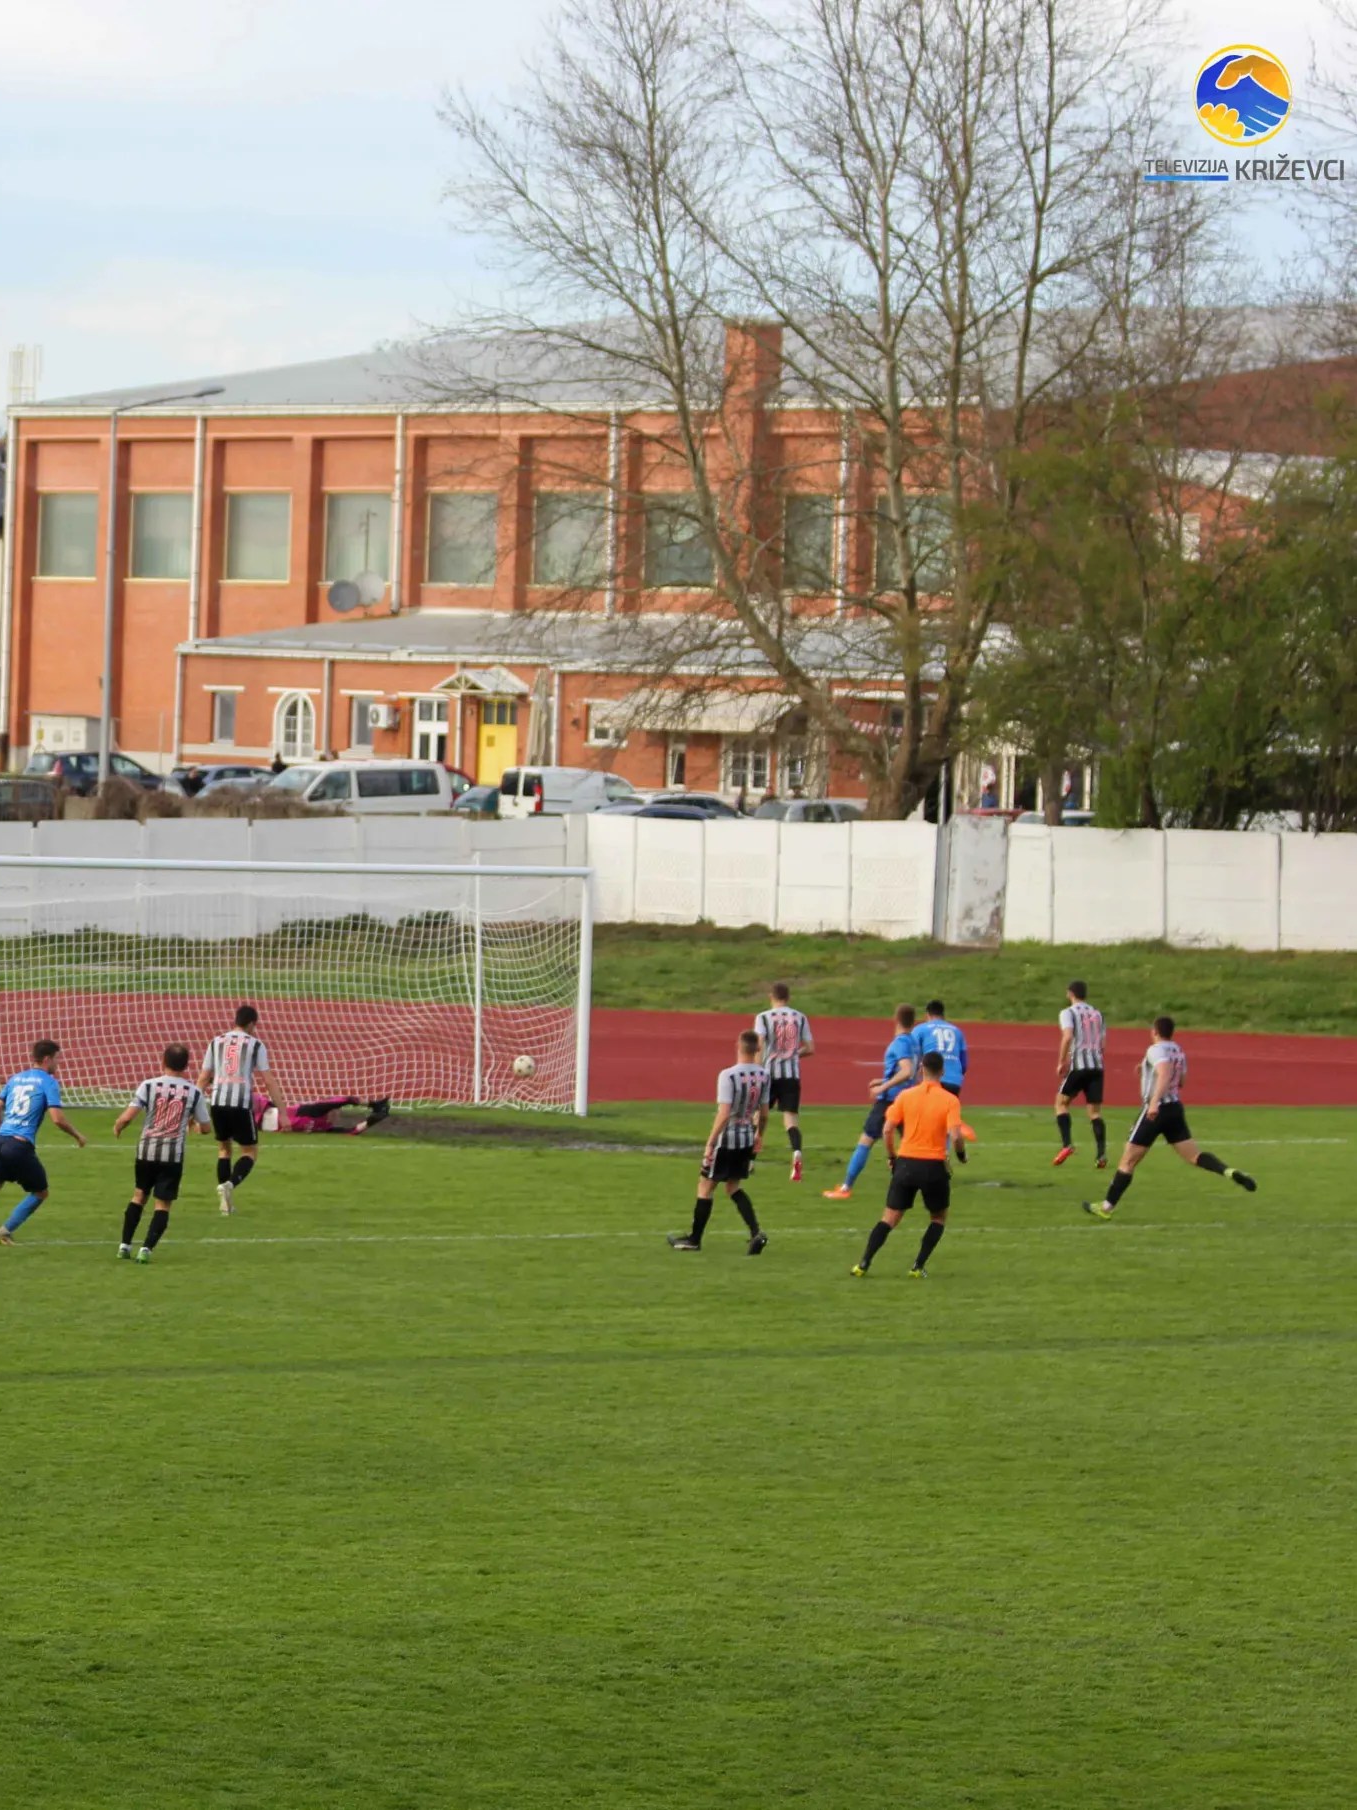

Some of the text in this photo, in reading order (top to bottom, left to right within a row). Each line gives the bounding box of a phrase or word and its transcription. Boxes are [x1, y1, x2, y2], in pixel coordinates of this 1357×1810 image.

[932, 1027, 956, 1053] 19
[225, 1045, 239, 1076] 5
[11, 1085, 35, 1117] 15
[154, 1097, 184, 1130] 10
